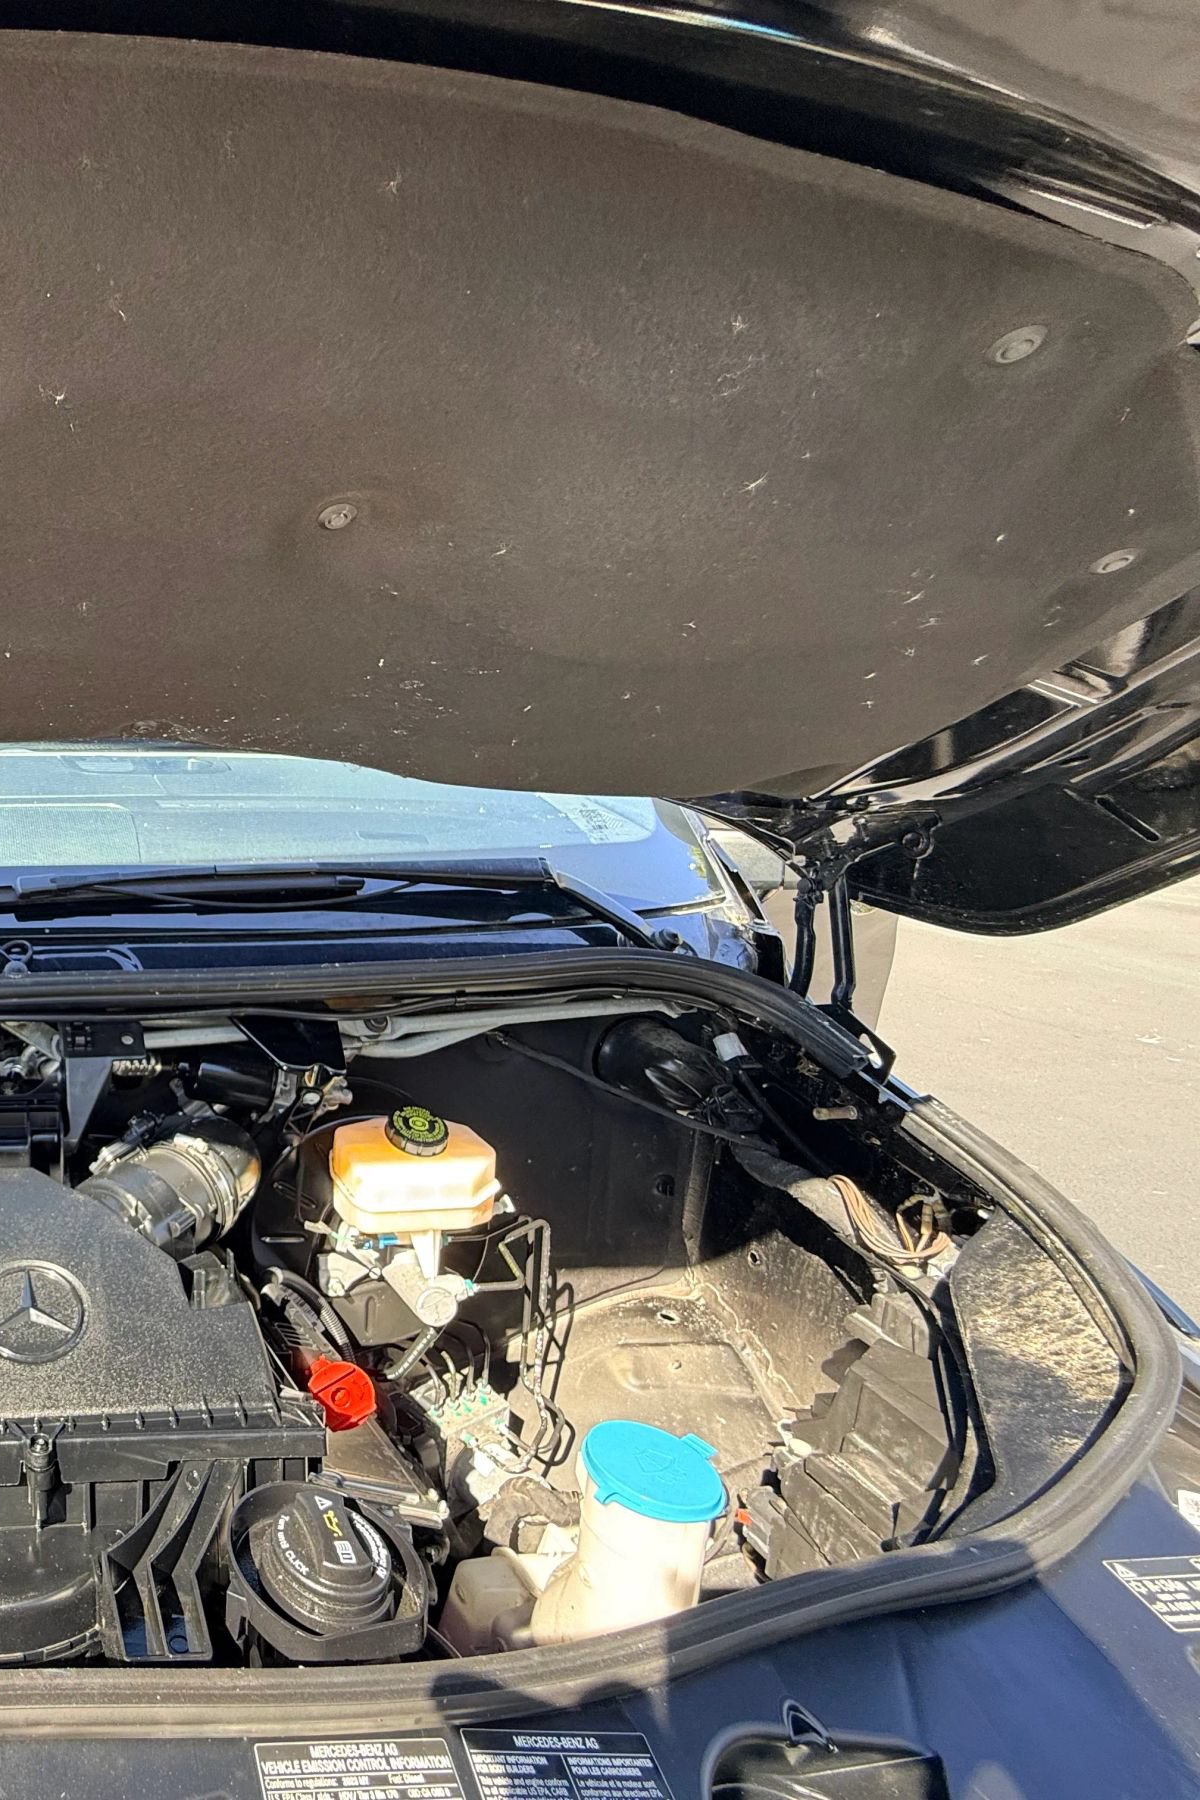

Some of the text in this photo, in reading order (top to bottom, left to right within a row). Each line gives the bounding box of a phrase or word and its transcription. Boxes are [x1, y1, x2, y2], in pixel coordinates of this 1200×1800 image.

[285, 1551, 309, 1575] CLICK
[513, 1735, 600, 1750] MERCEDES-BENZ AG
[309, 1743, 399, 1758] MERCEDES-BENZ AG
[261, 1755, 451, 1774] VEHICLE EMISSION CONTROL INFORMATION
[471, 1754, 549, 1765] IMPORTANT INFORMATION
[567, 1757, 612, 1766] INFORMATIONS
[475, 1763, 489, 1773] FOR
[505, 1765, 536, 1774] BUILDERS
[571, 1766, 589, 1775] POUR
